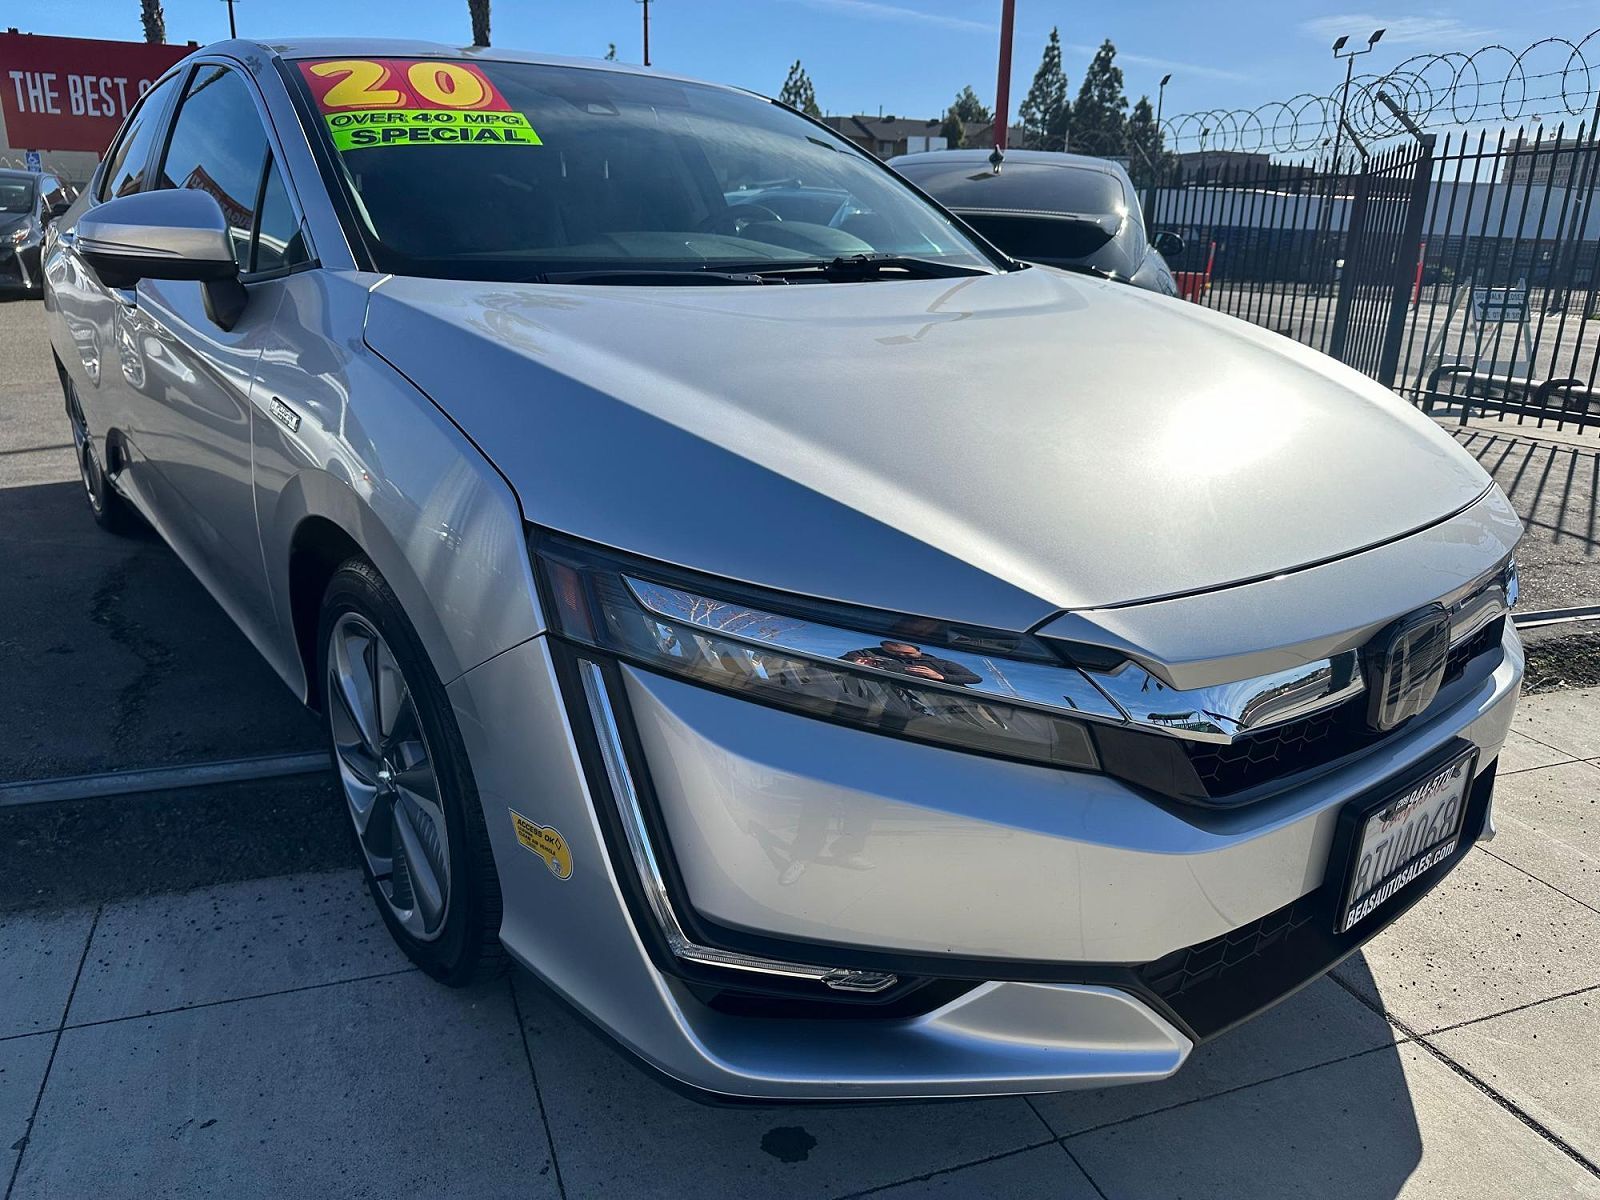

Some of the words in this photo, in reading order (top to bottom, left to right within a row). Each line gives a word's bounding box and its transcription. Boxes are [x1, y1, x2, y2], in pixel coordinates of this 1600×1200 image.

[9, 71, 61, 114] THE
[68, 75, 129, 118] BEST
[310, 60, 493, 108] 20
[331, 113, 408, 126] OVER
[412, 113, 456, 124] 40
[464, 113, 523, 126] MPG
[351, 127, 530, 146] SPECIAL
[517, 819, 543, 838] ACCESS
[544, 834, 555, 845] OK
[1355, 795, 1458, 900] 8TUA068
